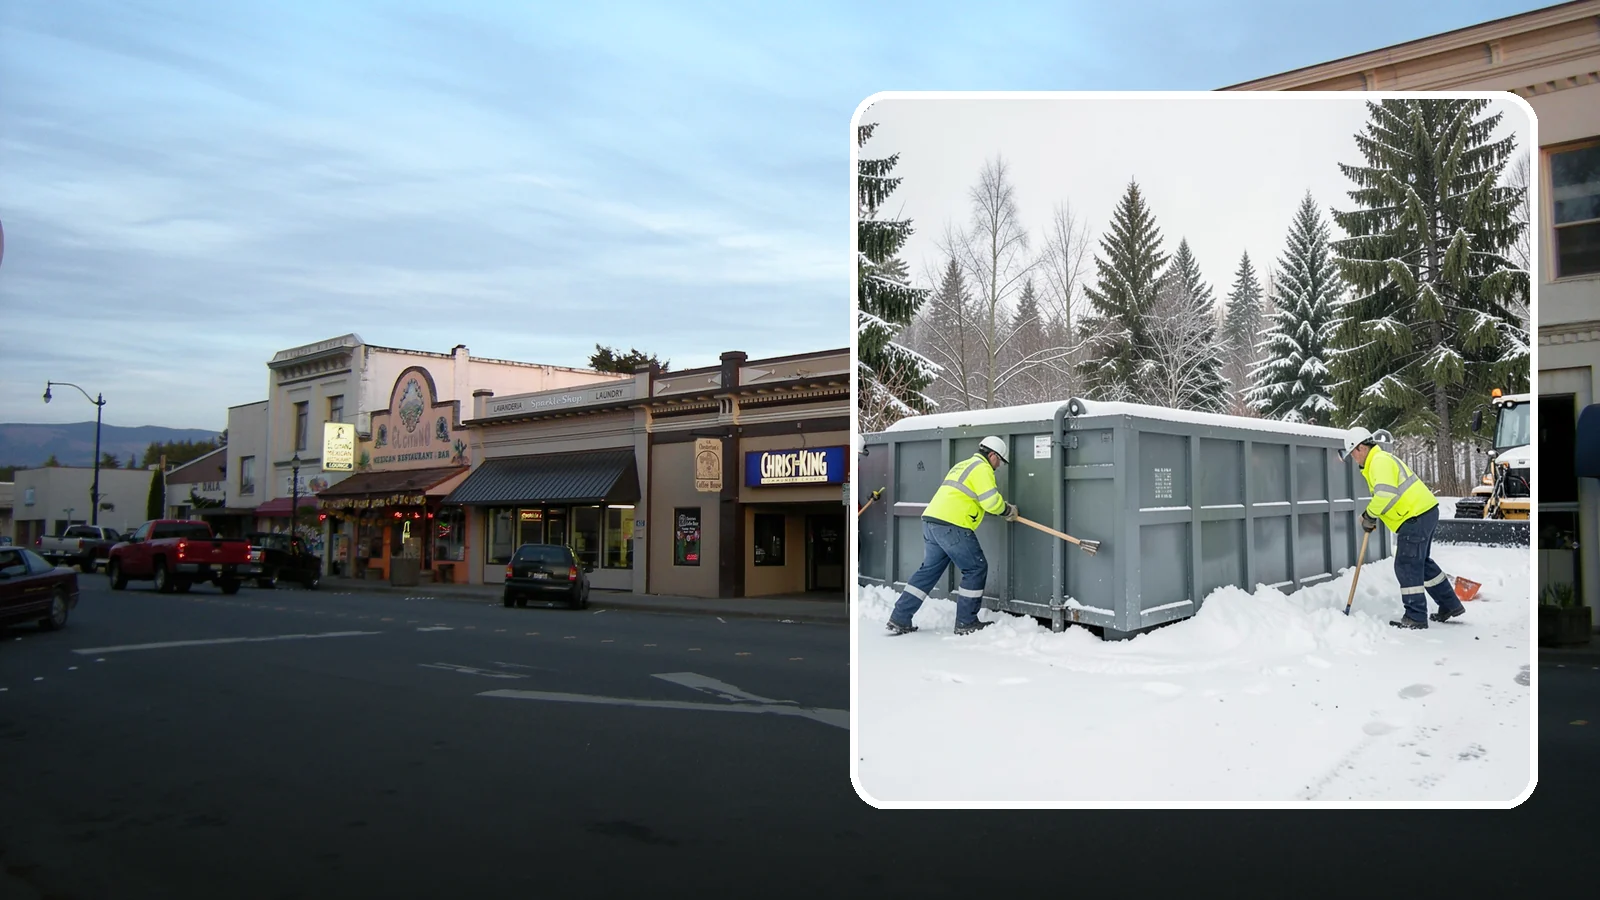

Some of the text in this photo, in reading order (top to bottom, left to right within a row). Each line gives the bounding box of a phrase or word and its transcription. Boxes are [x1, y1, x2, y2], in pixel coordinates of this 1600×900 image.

[595, 389, 623, 399] LAUNDRY
[493, 402, 522, 412] LAVANDERIA
[531, 394, 582, 409] Sparkle Shop
[398, 451, 433, 462] RESTAURANT
[438, 450, 450, 459] BAR
[799, 450, 827, 476] KING
[697, 481, 722, 489] Coffee House
